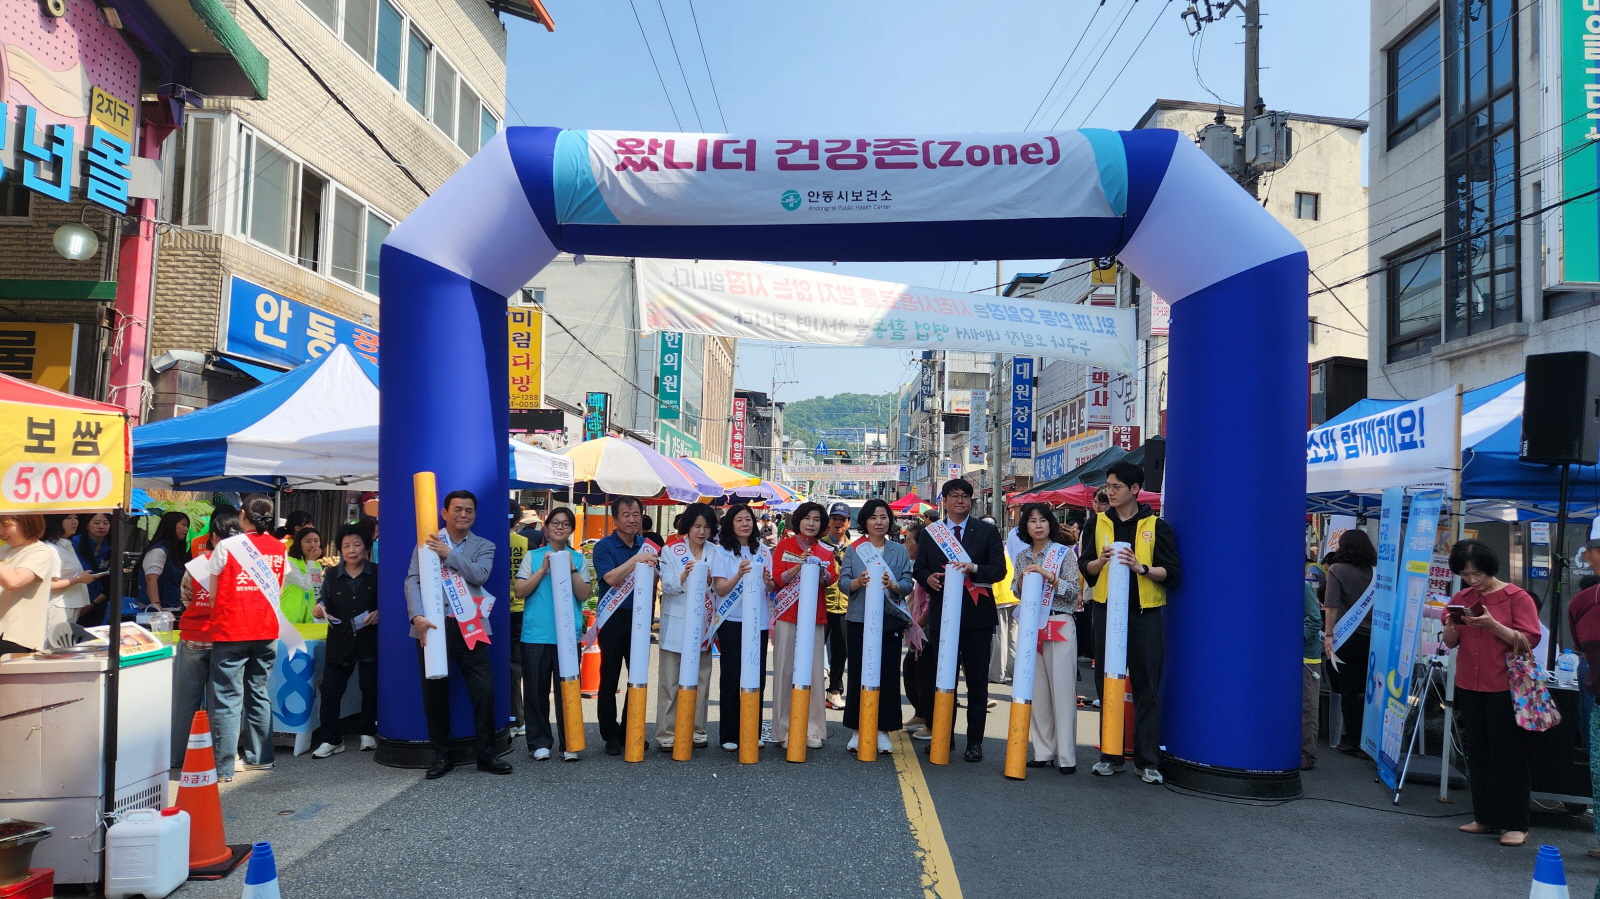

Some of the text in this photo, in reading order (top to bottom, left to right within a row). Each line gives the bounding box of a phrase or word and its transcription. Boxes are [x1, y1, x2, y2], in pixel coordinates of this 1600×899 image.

[95, 92, 130, 127] 2지구
[0, 102, 132, 214] 년몰
[614, 135, 1061, 172] 왔니더 건강존(Zone)
[807, 189, 893, 203] 안동시보건소
[255, 293, 337, 363] 안동
[511, 310, 533, 393] 미림다방
[662, 331, 681, 393] 한의원
[732, 400, 745, 463] 안동민속한우
[1013, 362, 1031, 445] 대원장식
[24, 416, 103, 457] 보쌈
[1307, 406, 1425, 465] 소와 함께해요!
[13, 466, 102, 503] 5,000
[1034, 453, 1065, 479] 대원지업사
